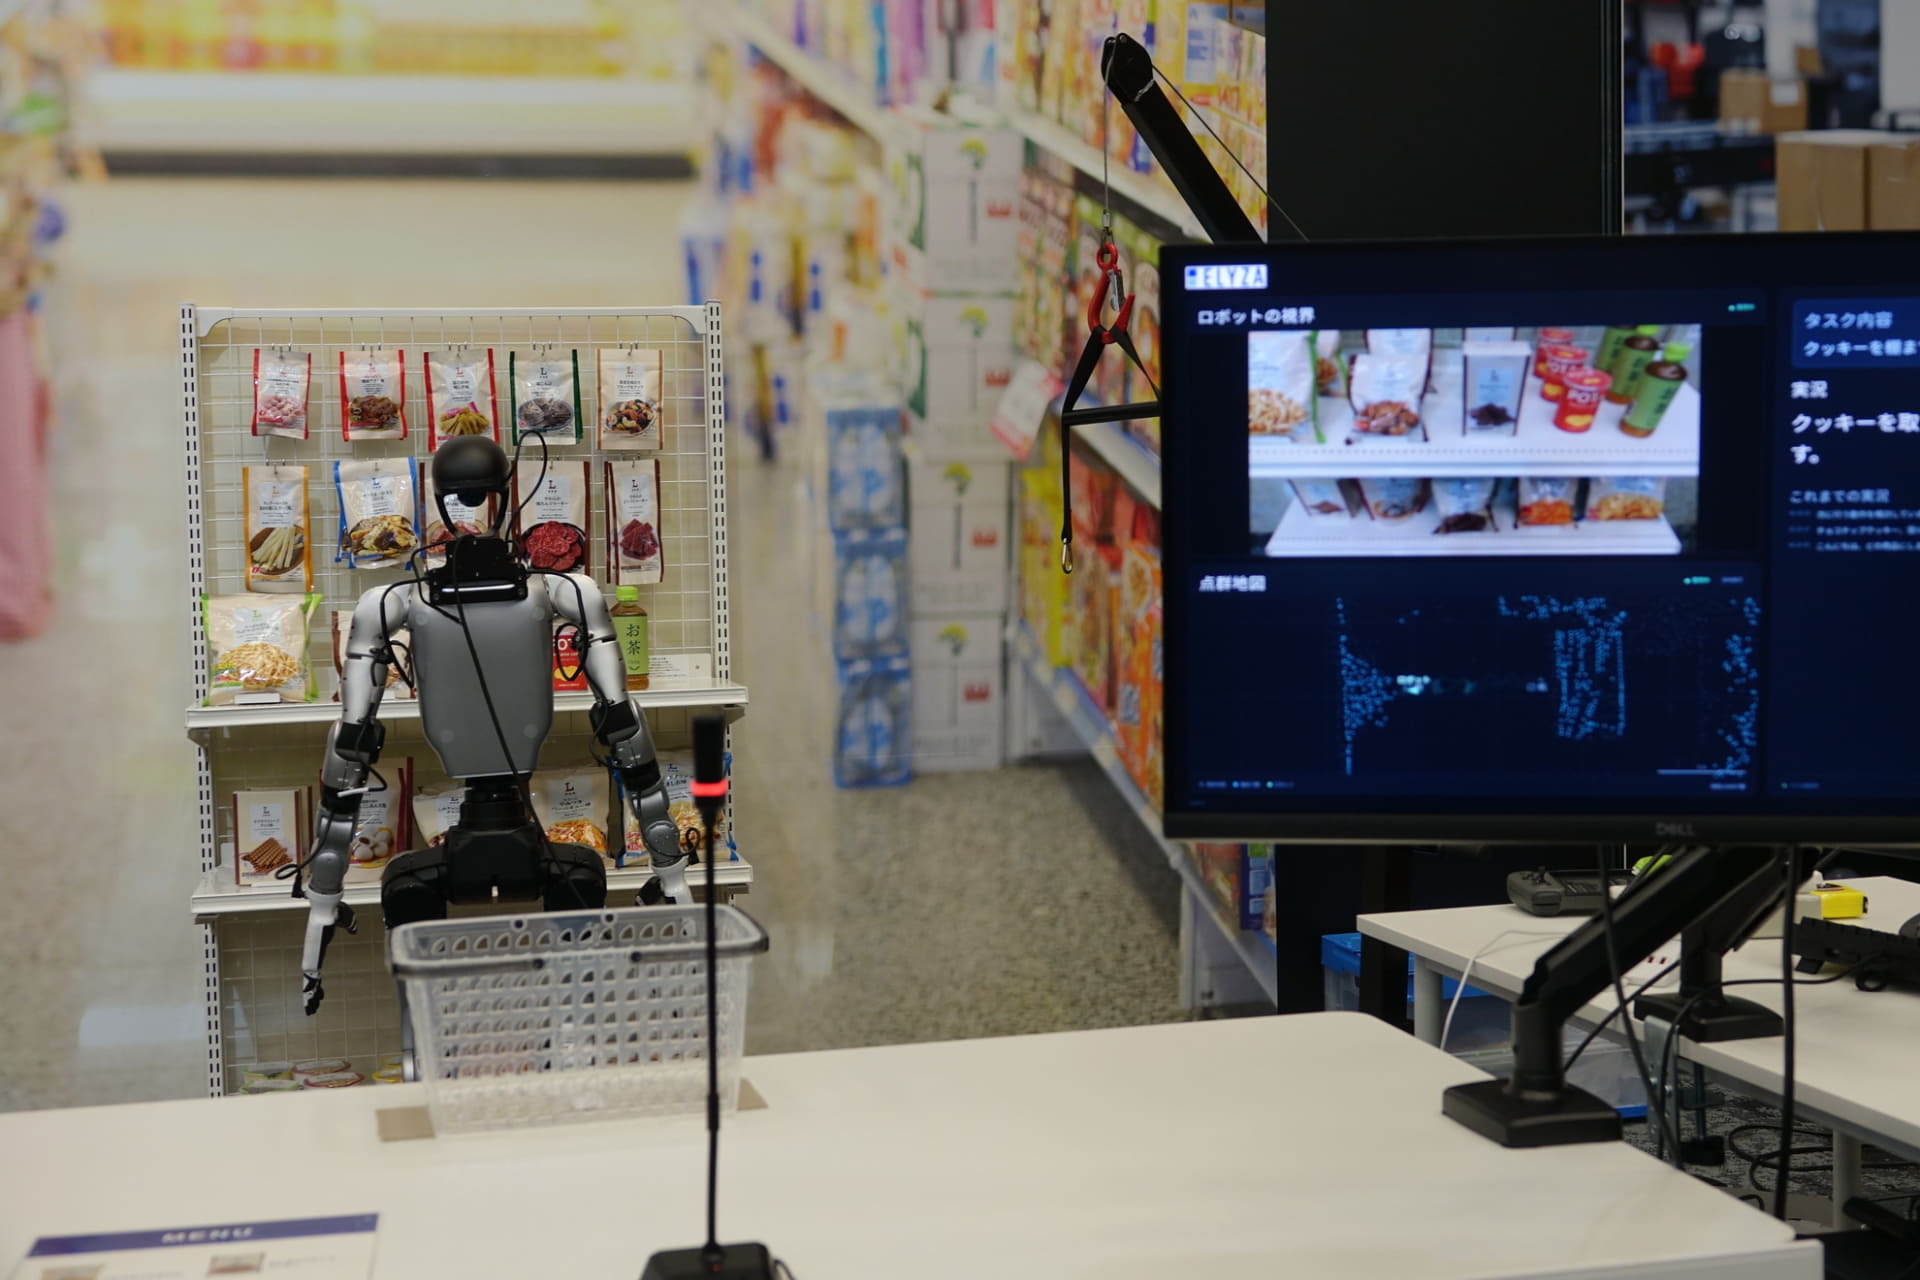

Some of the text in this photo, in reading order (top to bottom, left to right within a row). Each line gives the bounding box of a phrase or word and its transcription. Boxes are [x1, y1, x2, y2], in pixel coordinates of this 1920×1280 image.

[1203, 267, 1264, 287] ELYZA
[1197, 306, 1315, 325] ロボットの視界
[1804, 310, 1893, 329] タスク内容
[540, 367, 548, 376] L
[1790, 444, 1820, 465] す。
[549, 480, 557, 489] L
[626, 623, 641, 655] お茶
[565, 782, 575, 792] L
[160, 1226, 253, 1245] MENU
